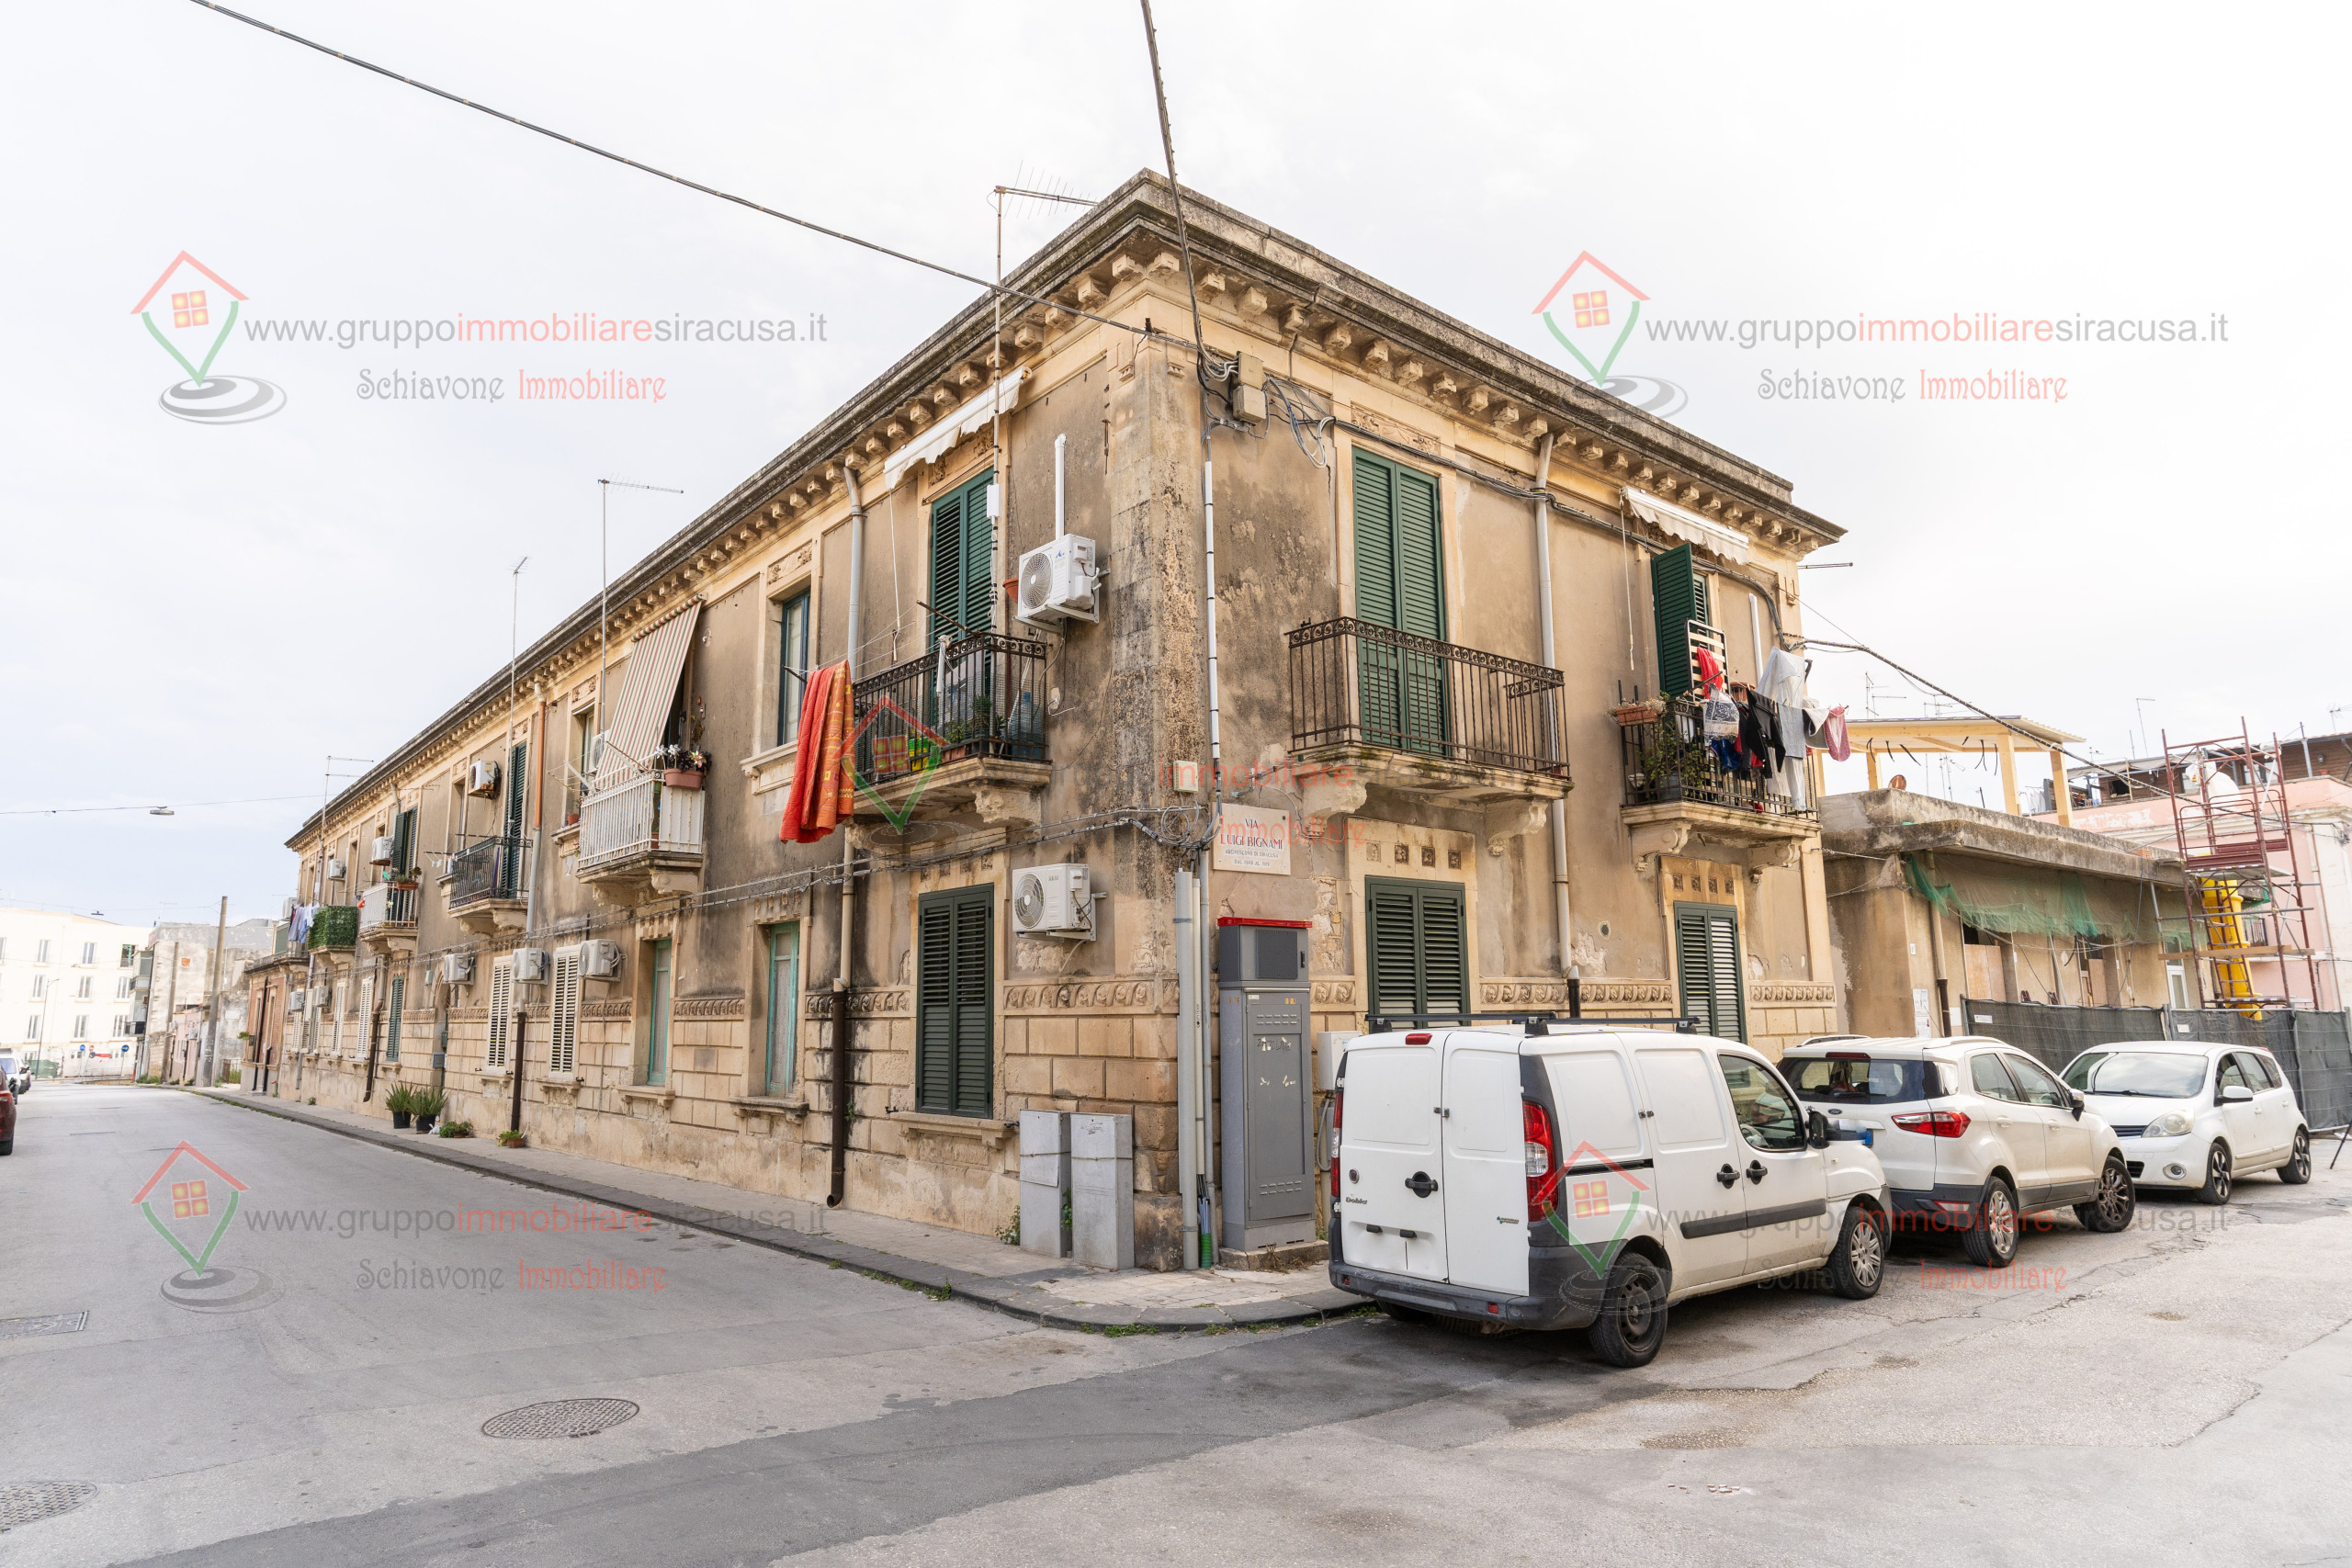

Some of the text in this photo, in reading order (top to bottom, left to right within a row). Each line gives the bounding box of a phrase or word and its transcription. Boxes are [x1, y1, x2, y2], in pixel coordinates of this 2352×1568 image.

[1245, 818, 1259, 829] VIA
[1220, 834, 1283, 850] LUIGI BIGNAMI
